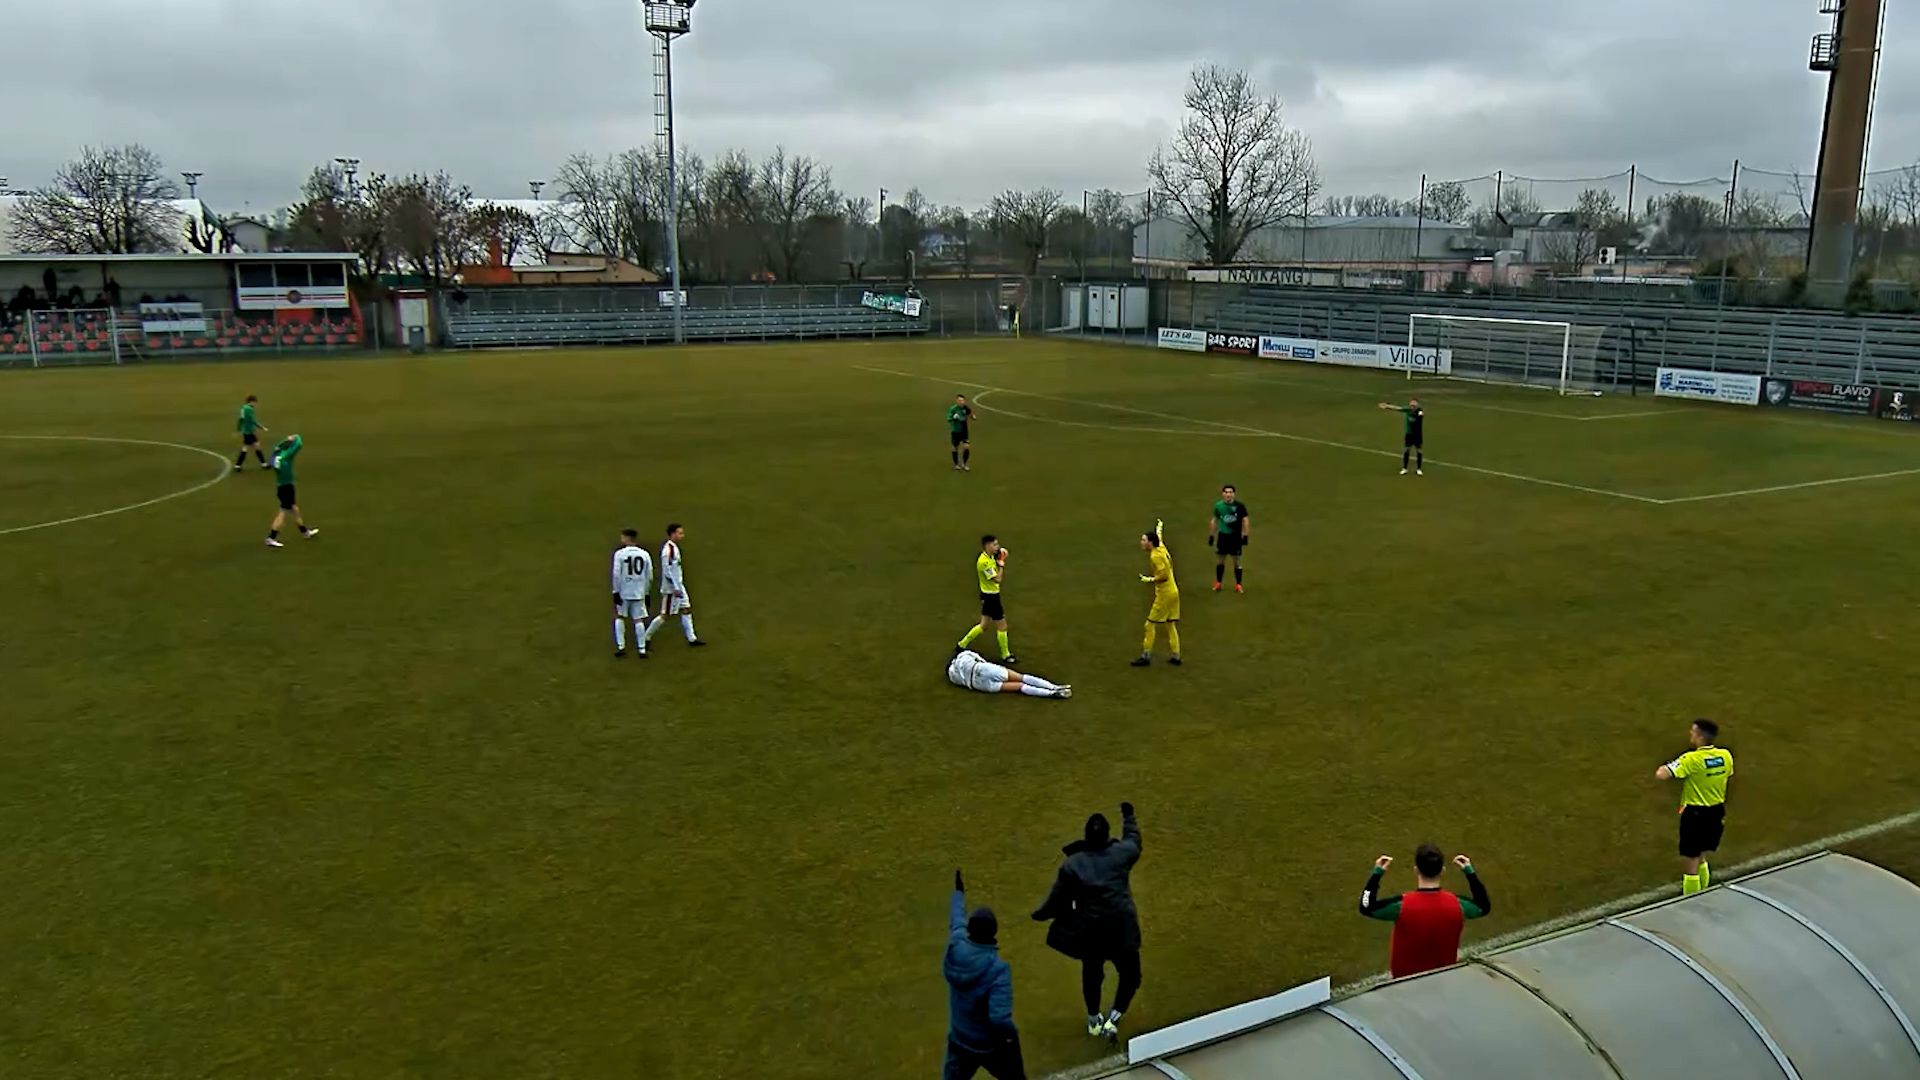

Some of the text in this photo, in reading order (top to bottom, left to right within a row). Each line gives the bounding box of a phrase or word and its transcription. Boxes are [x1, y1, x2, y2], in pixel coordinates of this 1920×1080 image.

[1228, 269, 1303, 284] NANKANG
[1208, 334, 1225, 345] BAR
[1227, 335, 1257, 349] SPORT
[1832, 384, 1872, 397] FLAVIO
[624, 556, 643, 575] 10
